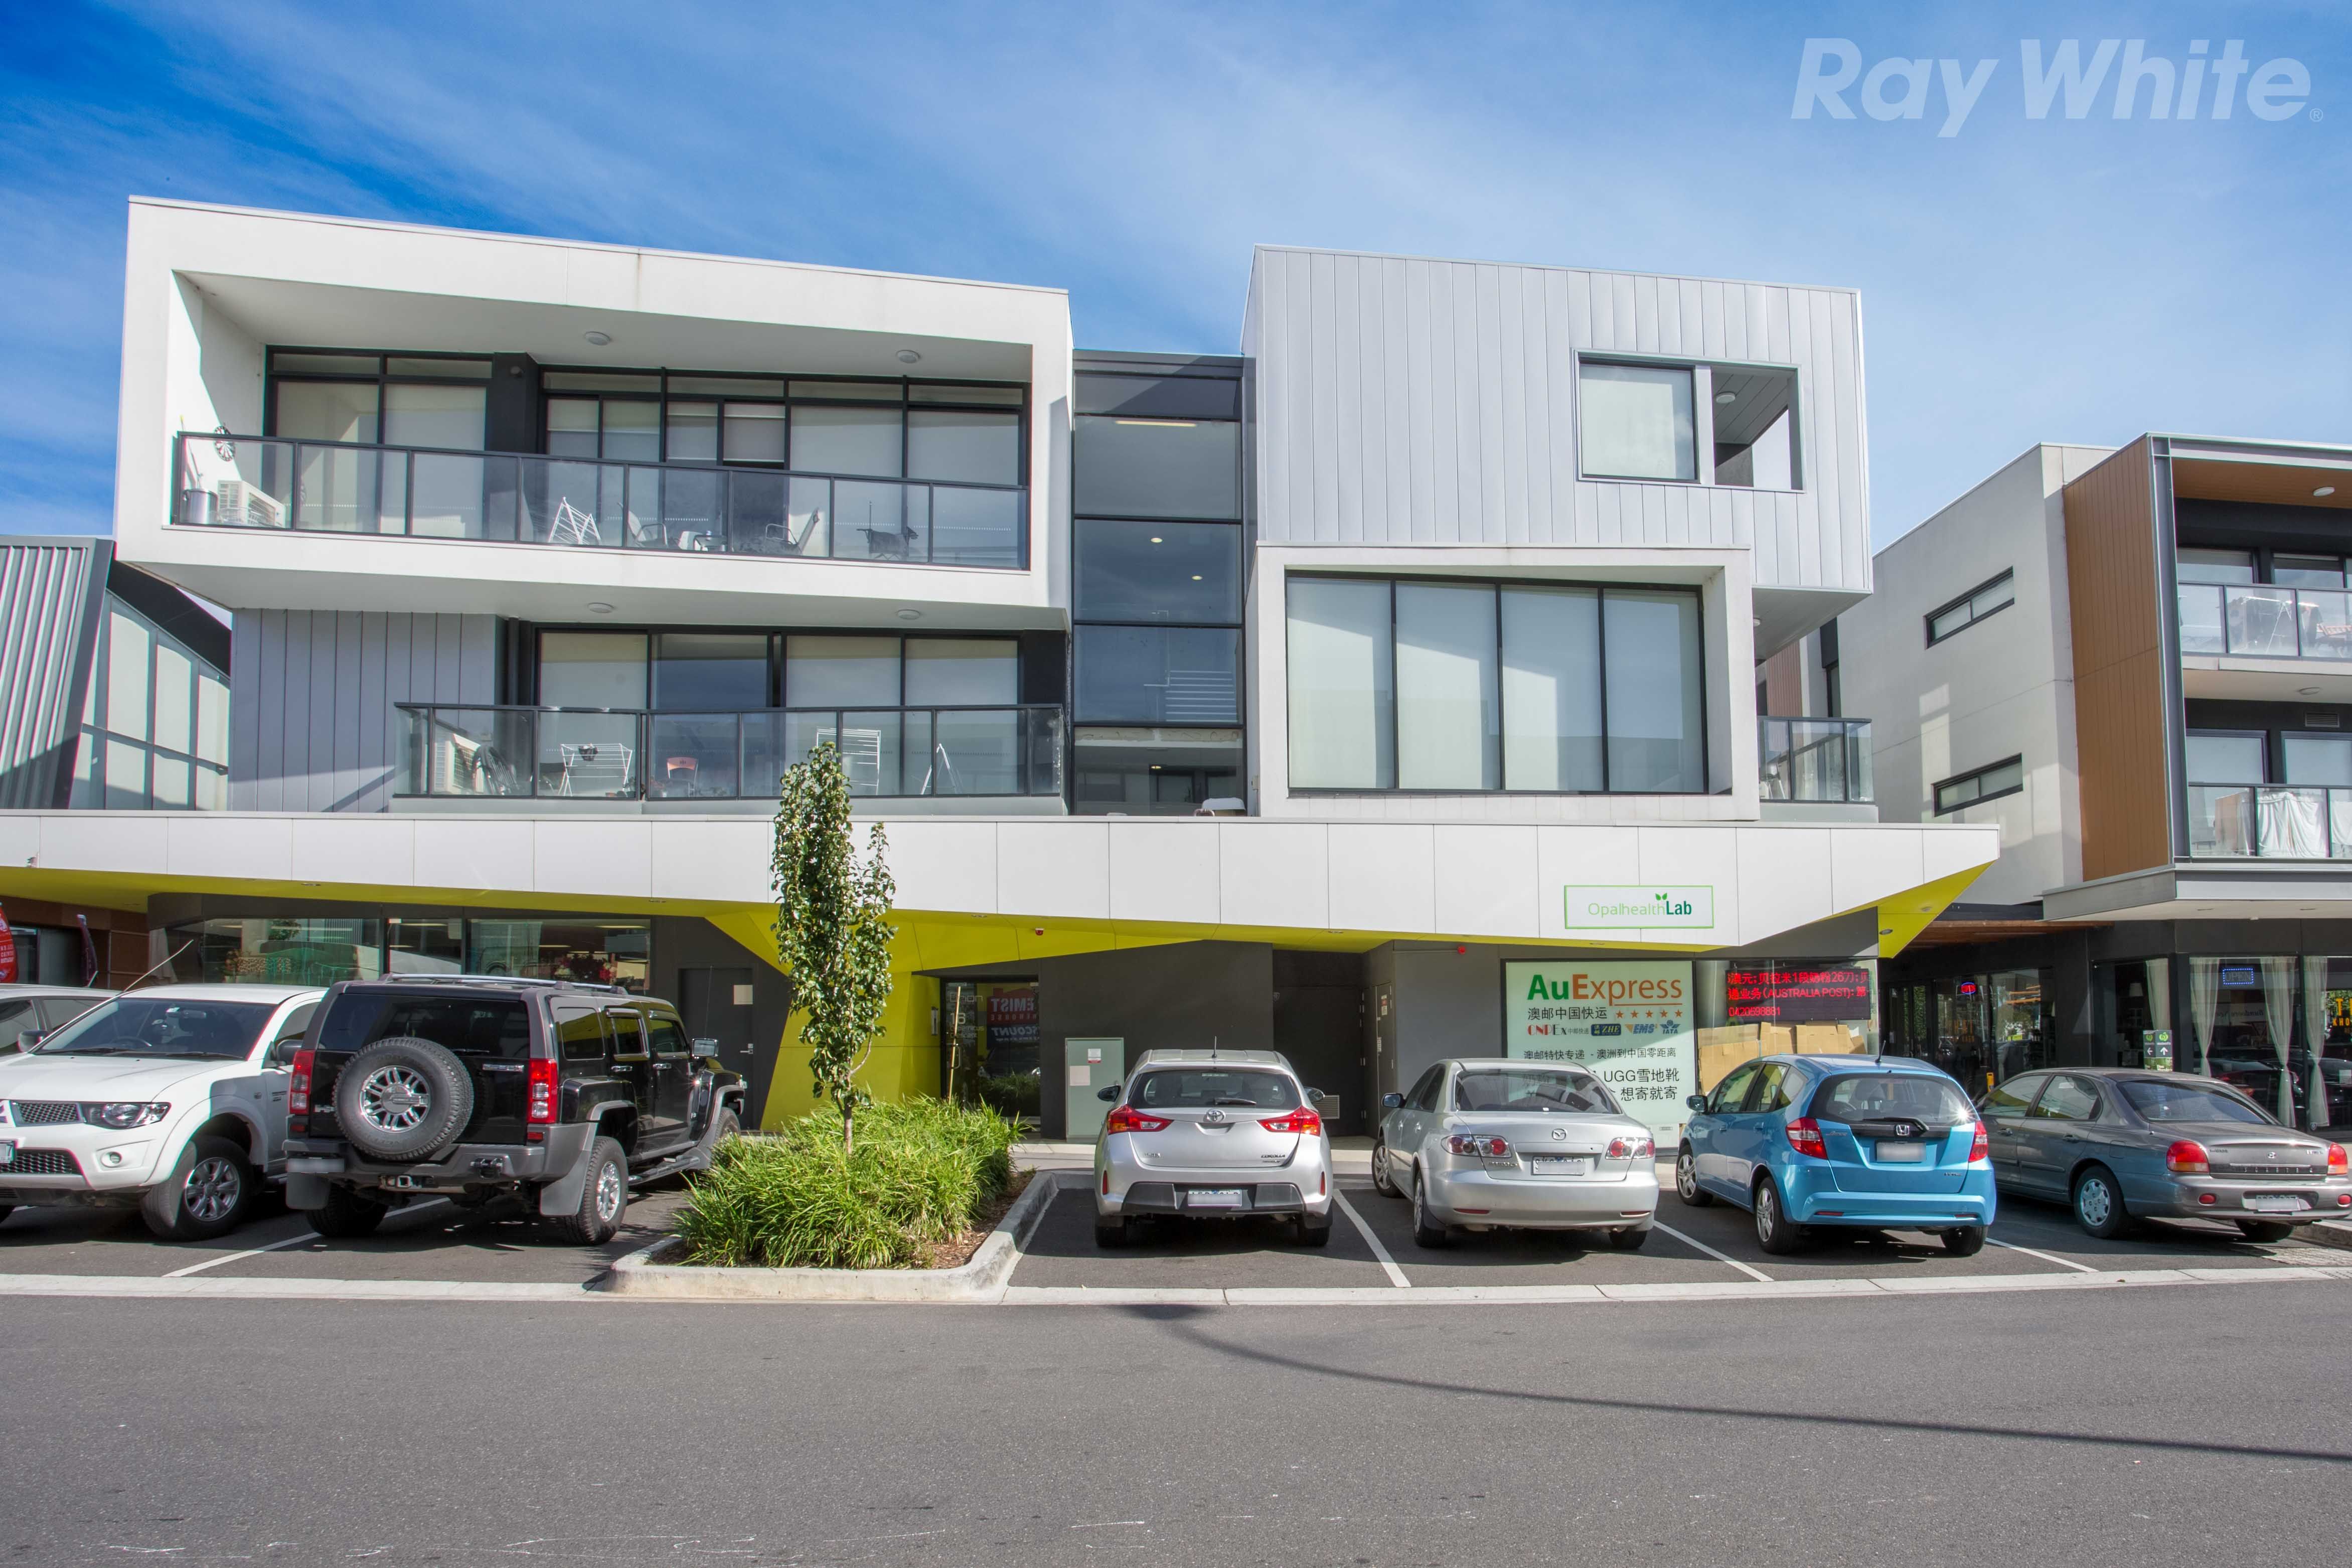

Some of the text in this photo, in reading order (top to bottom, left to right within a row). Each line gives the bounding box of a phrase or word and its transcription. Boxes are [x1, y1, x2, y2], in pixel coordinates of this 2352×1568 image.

[1588, 900, 1692, 918] OpalhealthLab
[1527, 974, 1682, 1006] AuExpress
[1528, 1007, 1607, 1020] 澳邮中国快运
[1633, 1024, 1655, 1034] EMS
[1597, 1047, 1676, 1059] 澳洲到中国零距离
[1604, 1068, 1679, 1082] UGG雪地靴
[1621, 1085, 1677, 1101] 想寄就寄
